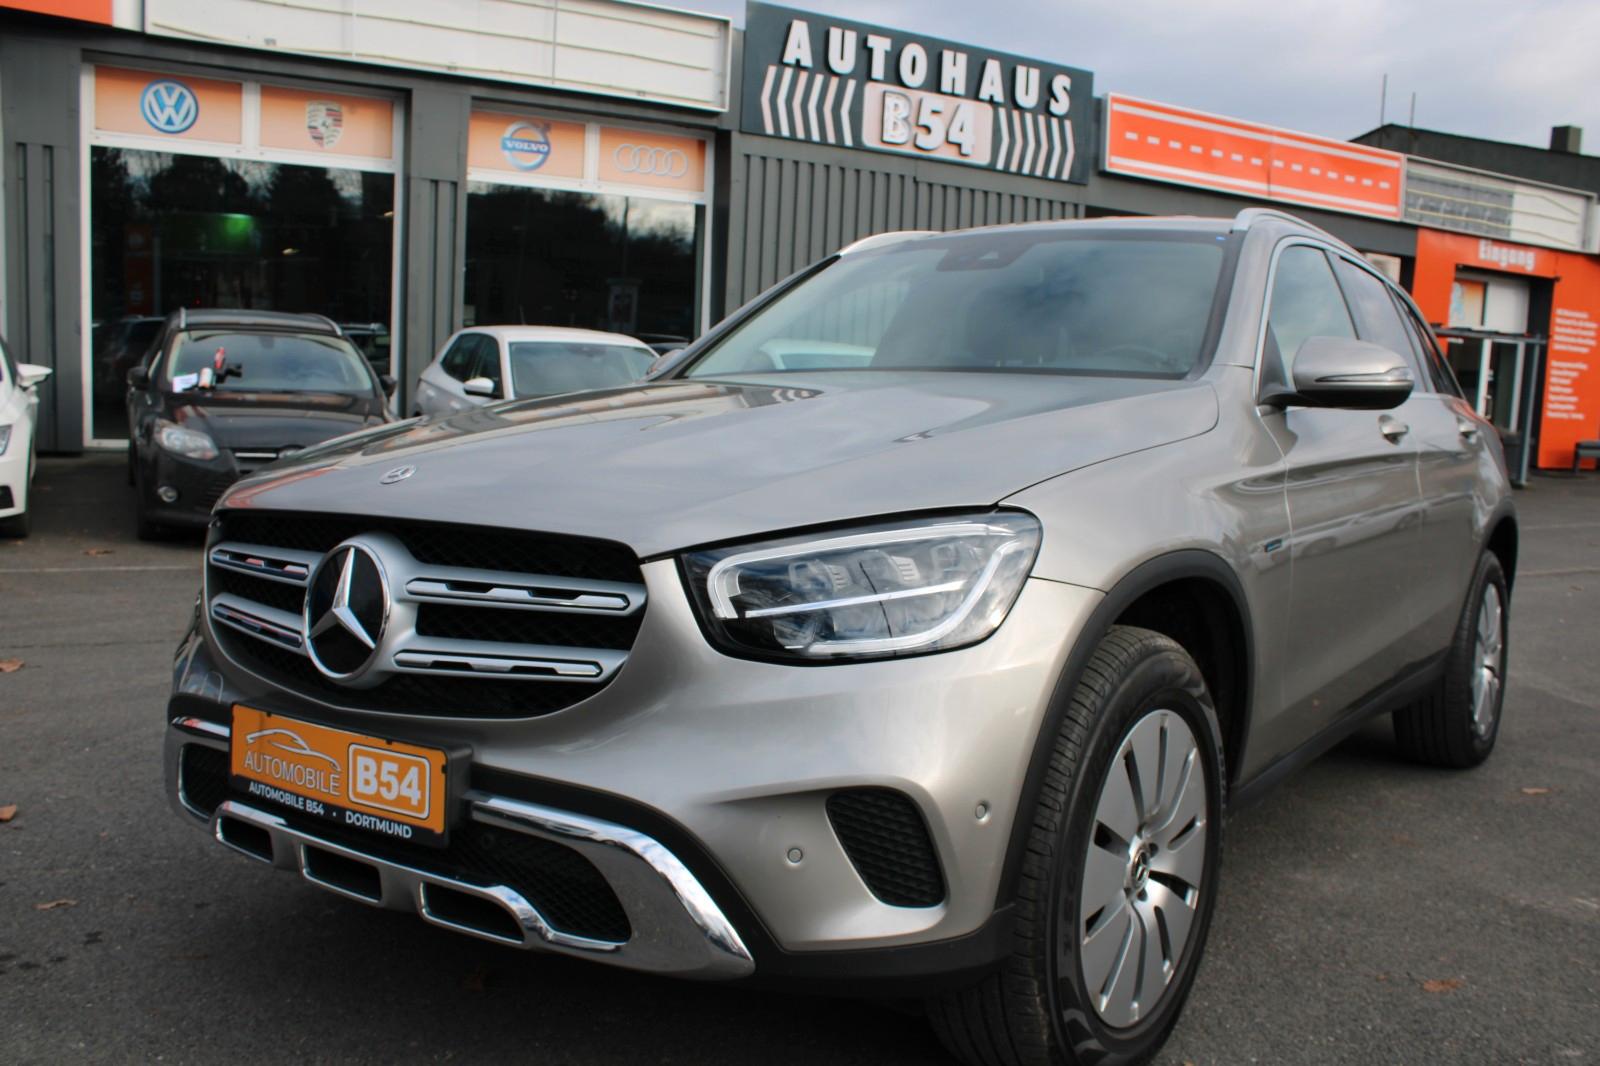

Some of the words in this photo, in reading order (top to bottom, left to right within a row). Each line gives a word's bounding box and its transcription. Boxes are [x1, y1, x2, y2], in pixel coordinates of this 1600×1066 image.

[783, 19, 1072, 117] AUTOHAUS
[505, 139, 549, 152] VOLVO
[882, 90, 976, 156] B54
[1479, 239, 1535, 272] Eingang
[244, 750, 342, 796] AUTOMOBILE
[356, 755, 422, 806] B54
[249, 782, 304, 810] AUTOMOBILE
[305, 797, 325, 816] B54
[345, 810, 412, 839] DORTMUND
